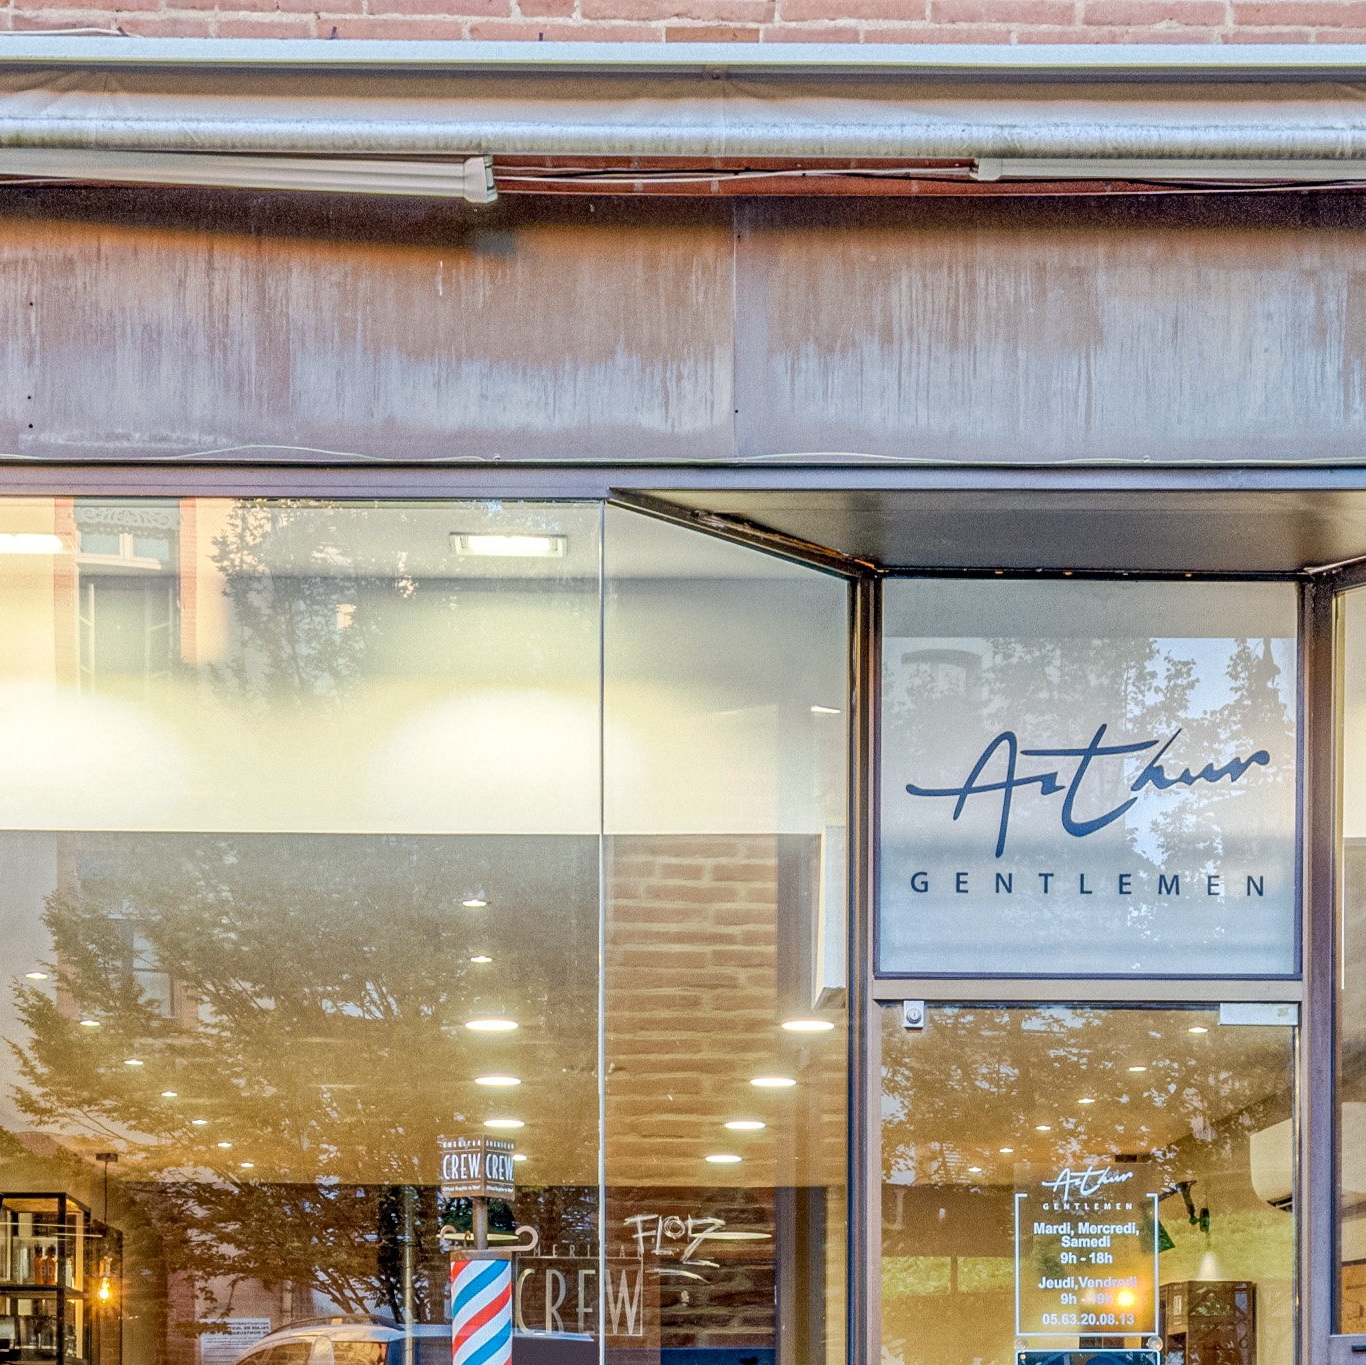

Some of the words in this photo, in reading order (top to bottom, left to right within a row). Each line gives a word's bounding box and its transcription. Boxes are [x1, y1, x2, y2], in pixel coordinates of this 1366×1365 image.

[906, 723, 1270, 858] Arthur
[911, 871, 1265, 896] GENTLEMEN
[1041, 1166, 1133, 1201] Arthur
[1033, 1222, 1075, 1236] Mardi,
[1078, 1222, 1140, 1236] Mercredi,
[1061, 1235, 1111, 1248] Samedi
[1060, 1252, 1077, 1264] 9h
[1089, 1252, 1113, 1264] 18h
[516, 1268, 642, 1335] CREW
[1060, 1293, 1077, 1305] 9h
[1042, 1313, 1135, 1325] 05.63.20.08.13
